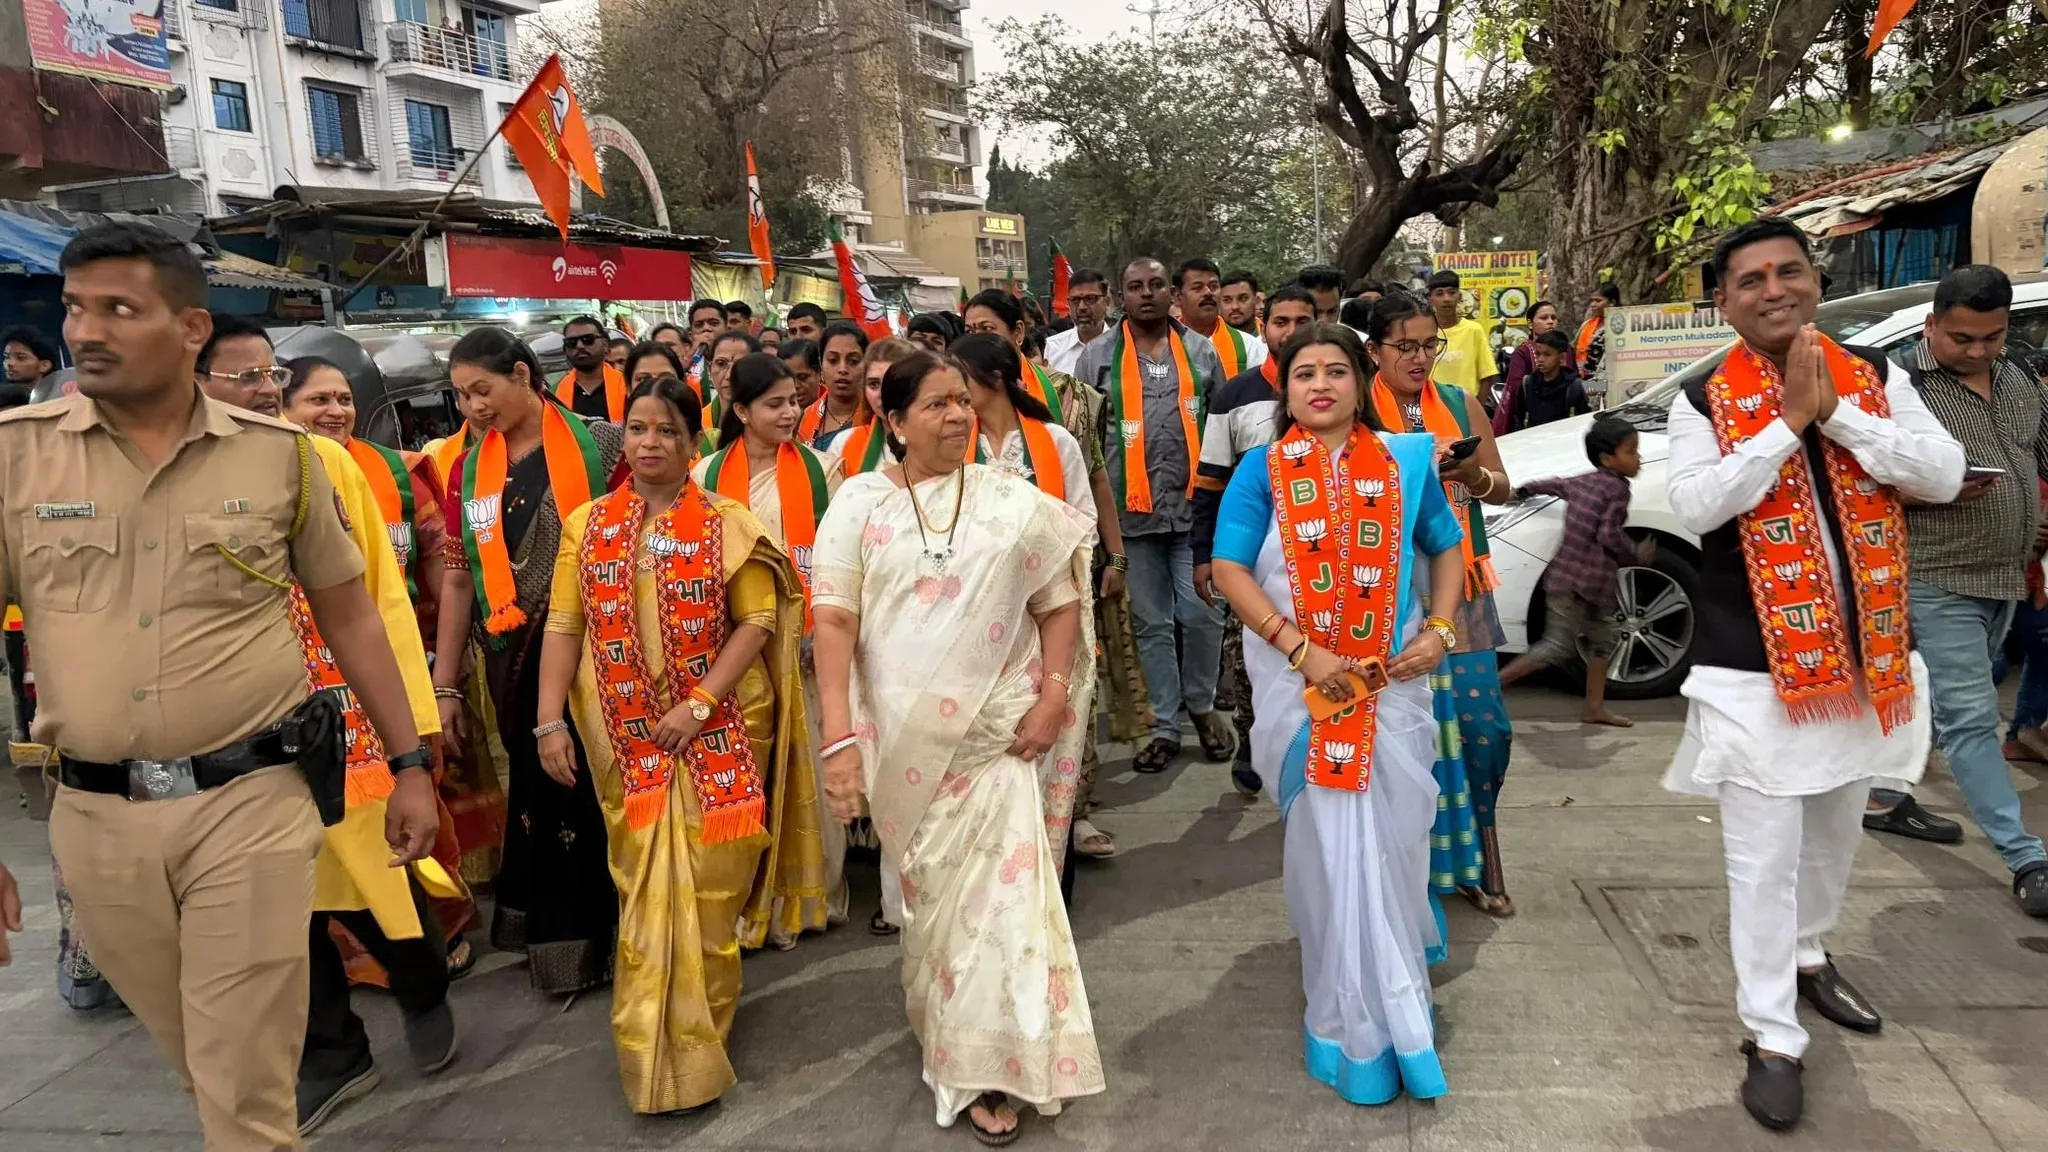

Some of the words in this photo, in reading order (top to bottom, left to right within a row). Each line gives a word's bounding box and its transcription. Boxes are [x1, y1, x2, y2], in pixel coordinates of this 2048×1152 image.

[1437, 255, 1486, 269] KAMAT
[1490, 253, 1533, 268] HOTEL
[567, 265, 583, 276] airtel
[378, 291, 395, 306] Jio
[1631, 311, 1686, 331] RAJAN
[1640, 335, 1683, 343] Narayan
[1685, 331, 1736, 341] Mukadam
[1290, 478, 1317, 504] B
[1310, 563, 1334, 593] J
[1357, 519, 1383, 549] B
[1350, 611, 1374, 640] J
